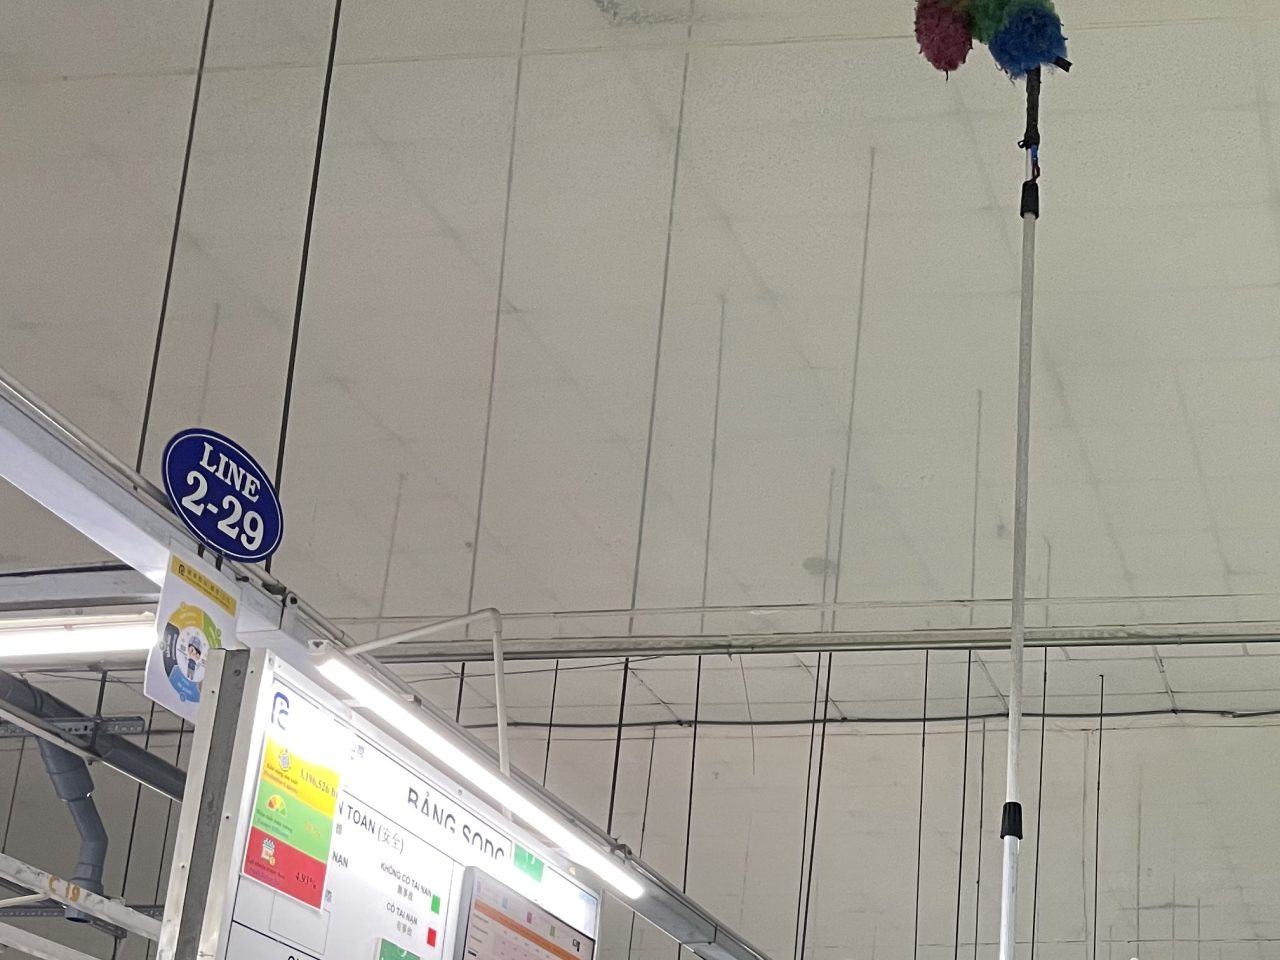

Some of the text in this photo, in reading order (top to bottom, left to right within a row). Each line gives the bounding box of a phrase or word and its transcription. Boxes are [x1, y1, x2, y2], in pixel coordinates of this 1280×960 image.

[199, 441, 261, 503] LINE
[181, 470, 264, 551] 2-29
[347, 804, 376, 835] TOÀN
